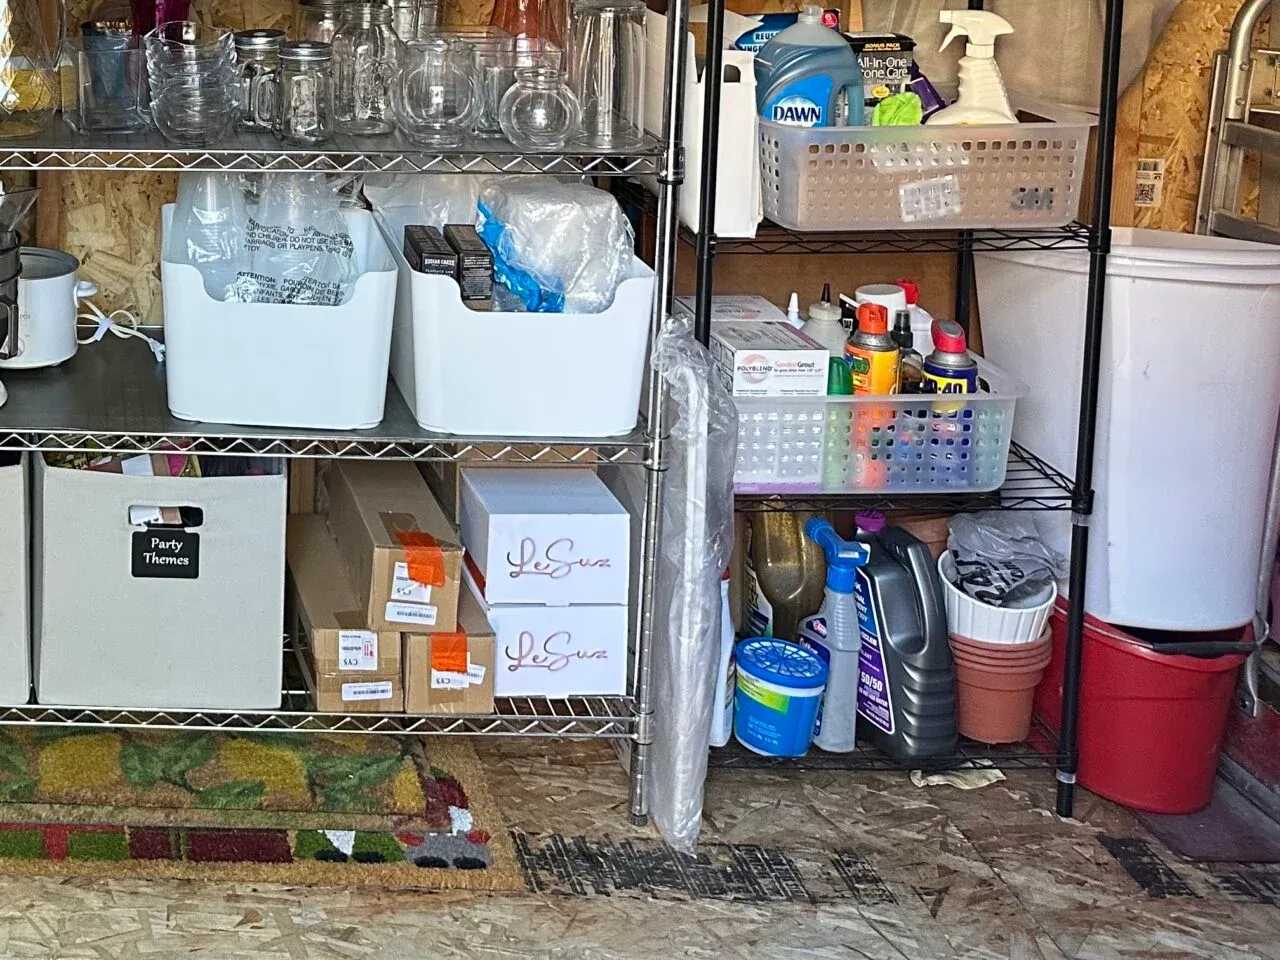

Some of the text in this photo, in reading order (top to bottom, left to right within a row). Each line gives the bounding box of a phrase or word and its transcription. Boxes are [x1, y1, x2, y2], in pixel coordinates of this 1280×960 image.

[887, 68, 908, 79] Care
[774, 106, 821, 122] DAWN
[151, 537, 183, 553] Party
[143, 552, 190, 565] Themes
[861, 671, 883, 692] 50/50
